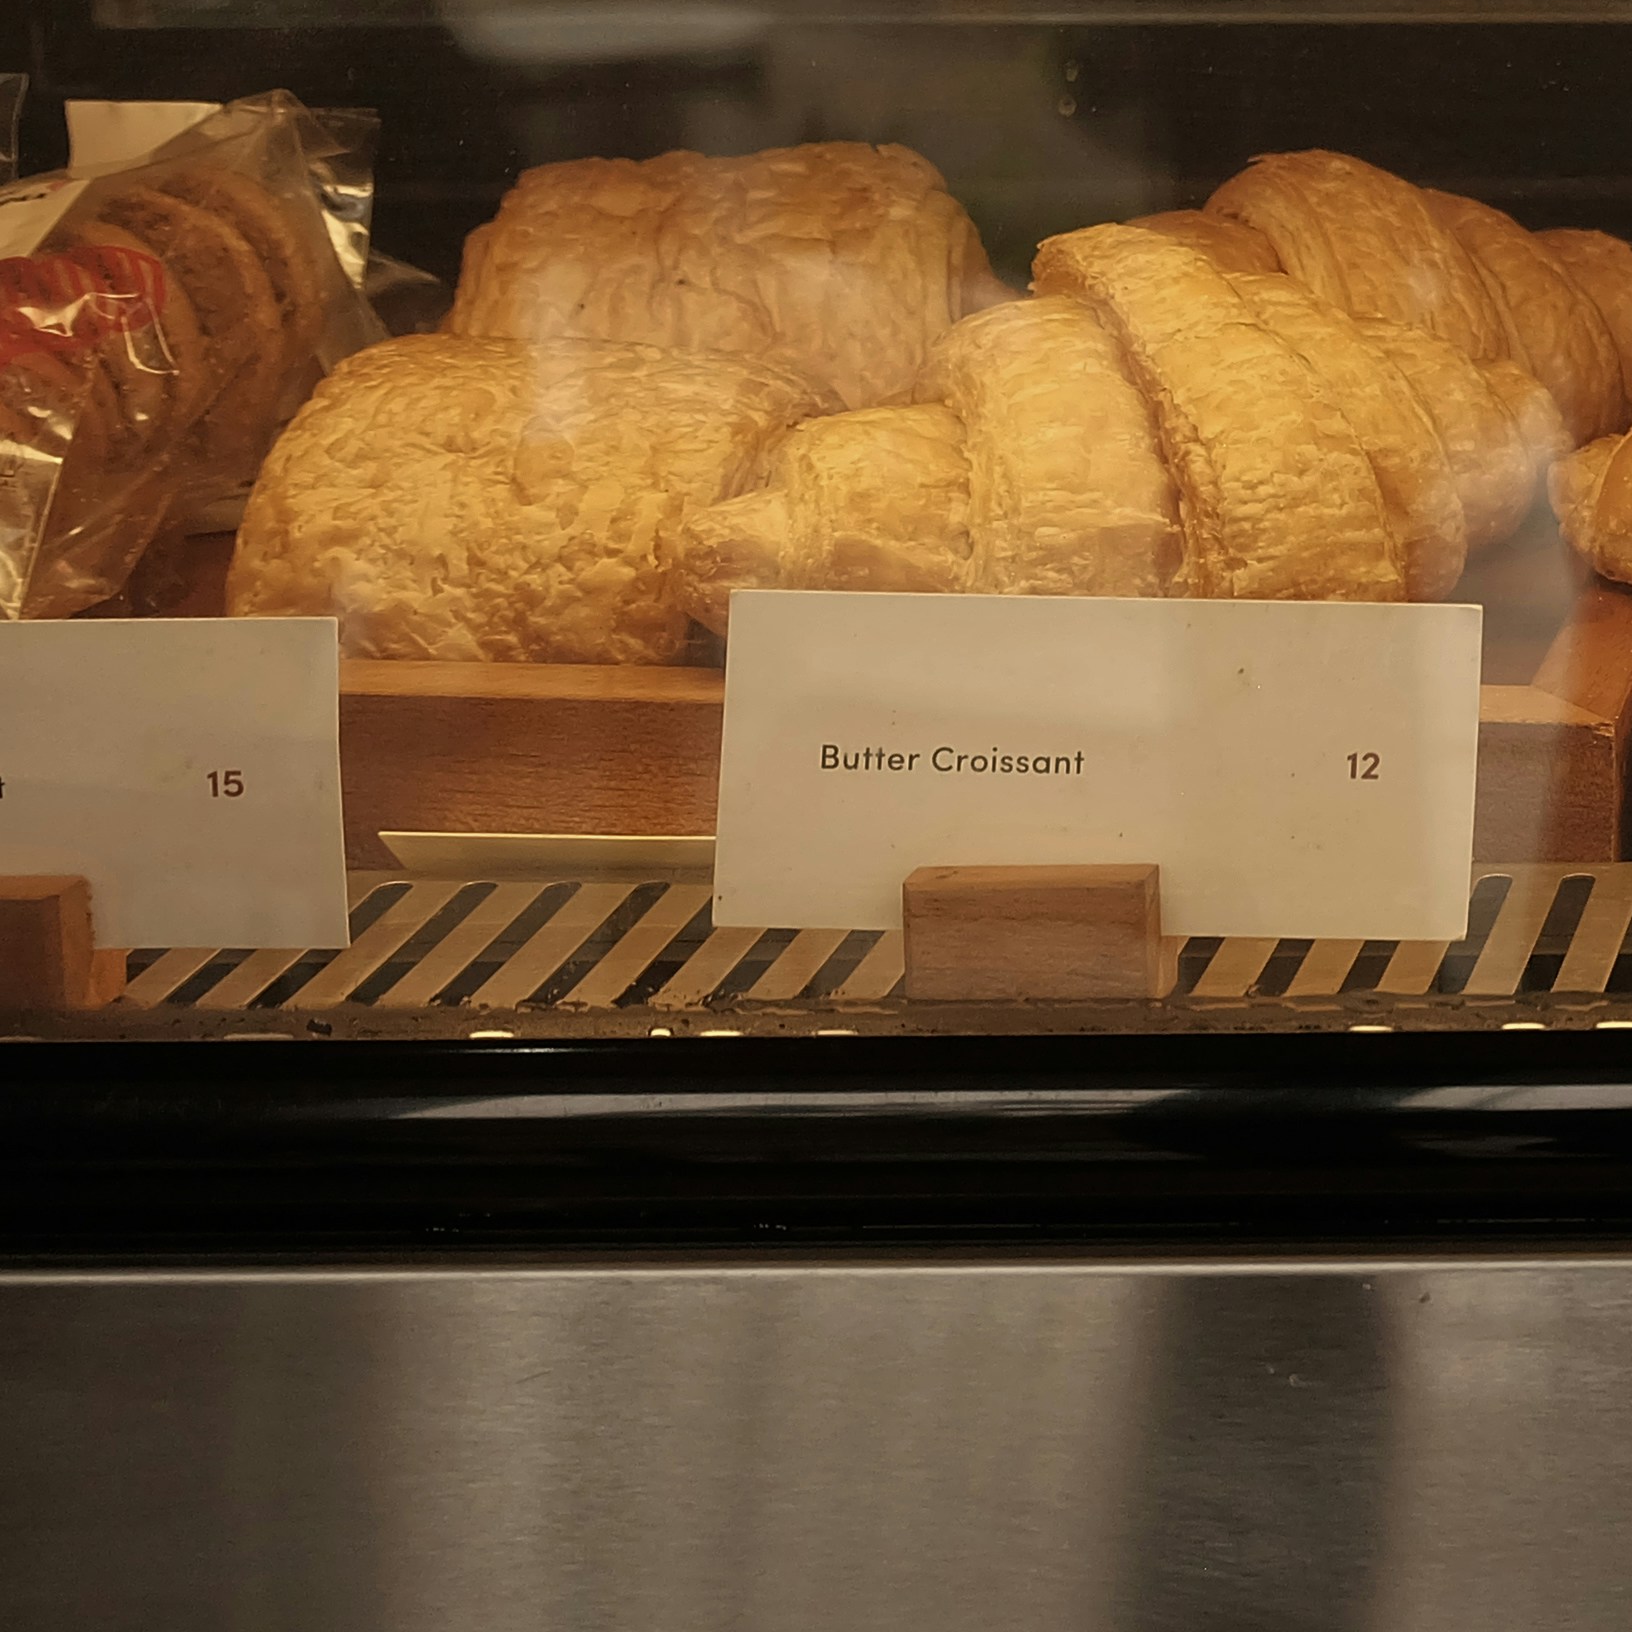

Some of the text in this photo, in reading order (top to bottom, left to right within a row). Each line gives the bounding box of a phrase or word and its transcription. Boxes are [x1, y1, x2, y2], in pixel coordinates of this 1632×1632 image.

[821, 744, 1380, 780] Butter Croissant 12
[206, 770, 244, 798] 15
